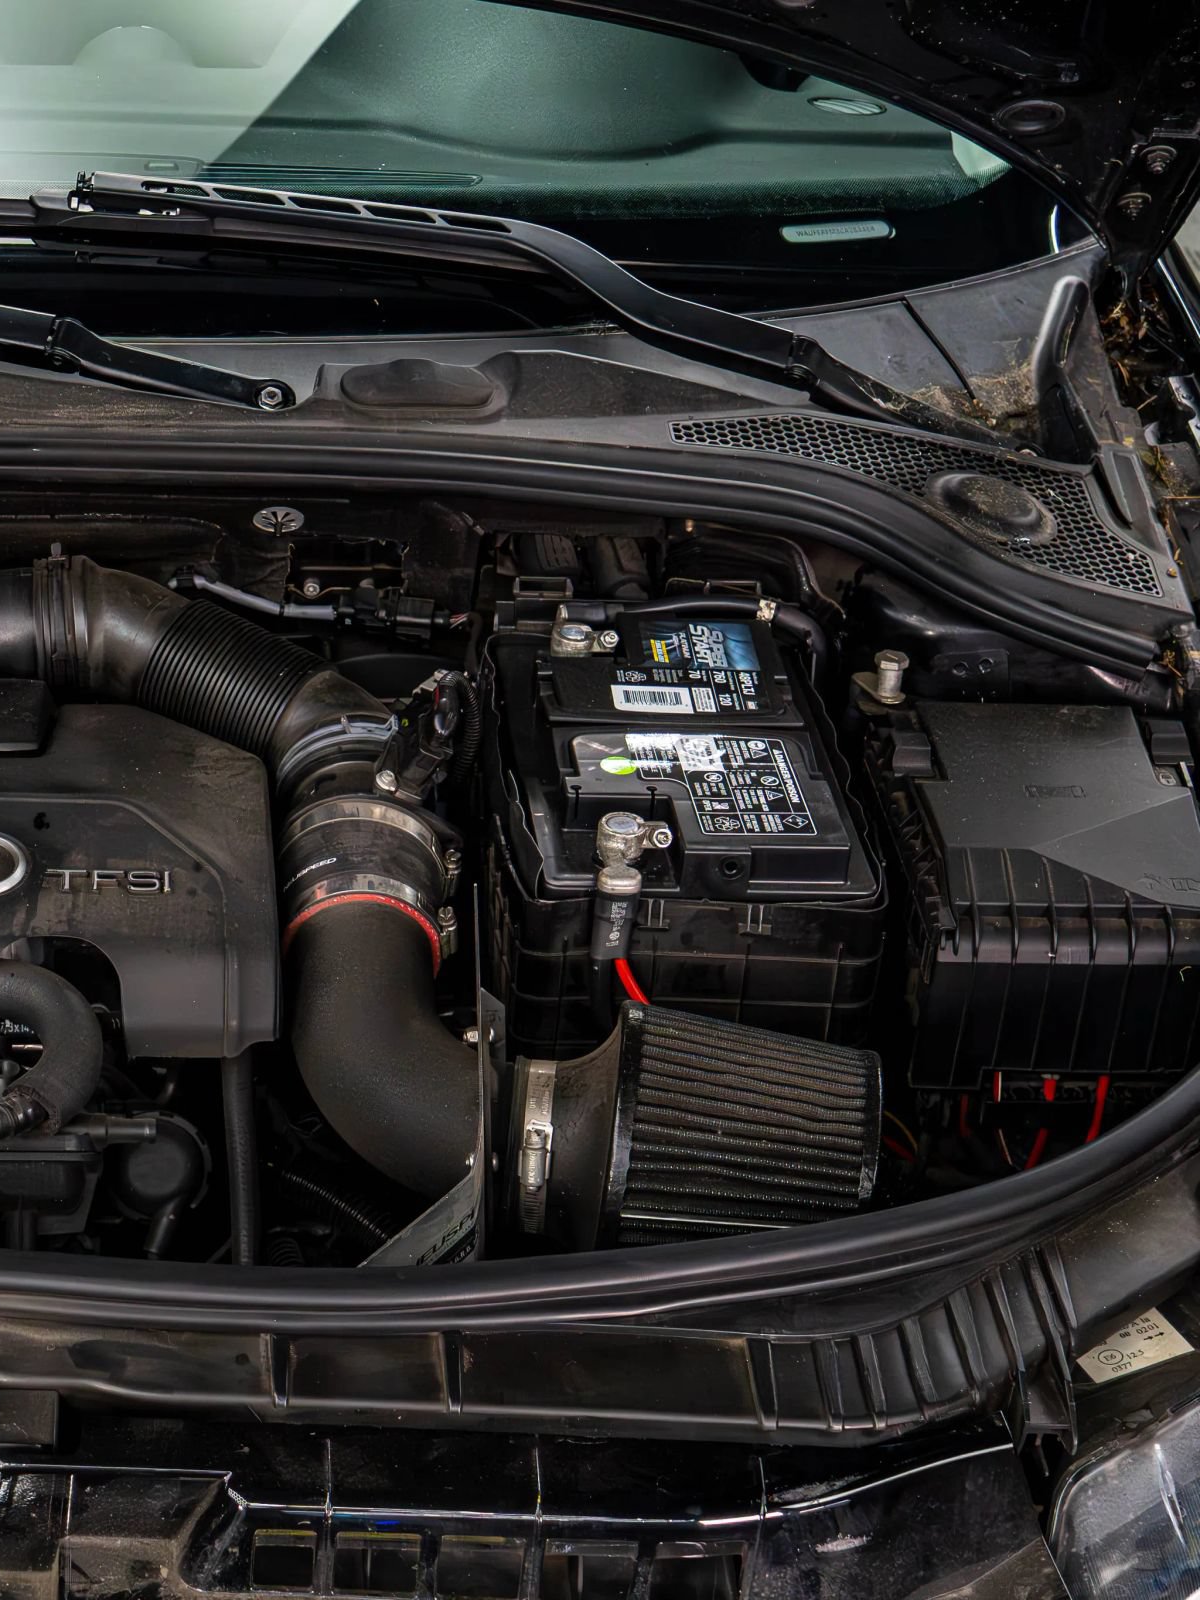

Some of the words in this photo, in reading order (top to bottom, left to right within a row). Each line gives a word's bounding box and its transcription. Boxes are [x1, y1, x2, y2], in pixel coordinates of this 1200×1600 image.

[678, 632, 691, 659] PLATINUM
[688, 624, 714, 668] START
[710, 630, 728, 668] SUPER
[688, 670, 701, 679] 70
[713, 671, 726, 683] 760
[719, 694, 732, 706] 120
[47, 868, 172, 894] TFSI
[1136, 1323, 1160, 1335] 0201
[1111, 1362, 1133, 1373] 0377
